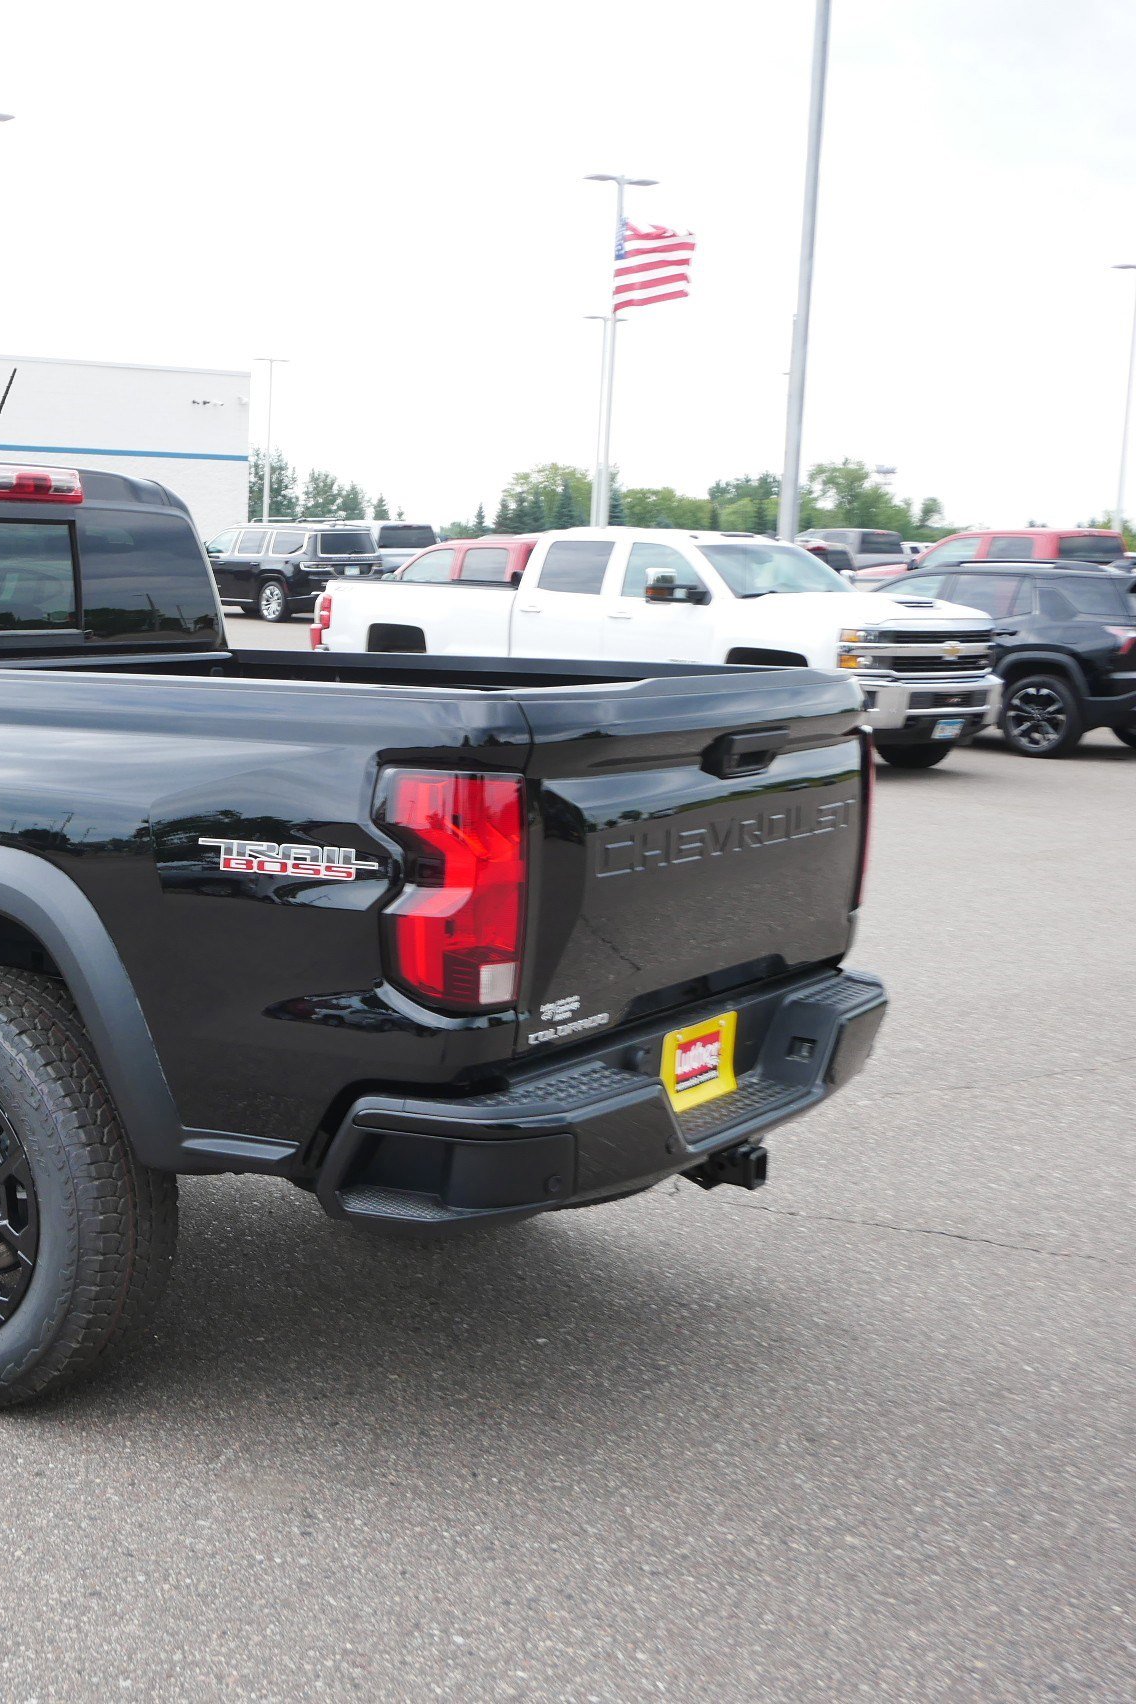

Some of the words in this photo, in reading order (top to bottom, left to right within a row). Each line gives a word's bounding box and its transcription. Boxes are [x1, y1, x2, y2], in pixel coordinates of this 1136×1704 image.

[198, 837, 379, 869] TRAIL
[595, 796, 857, 878] CHEVROLET
[220, 856, 356, 881] BOSS
